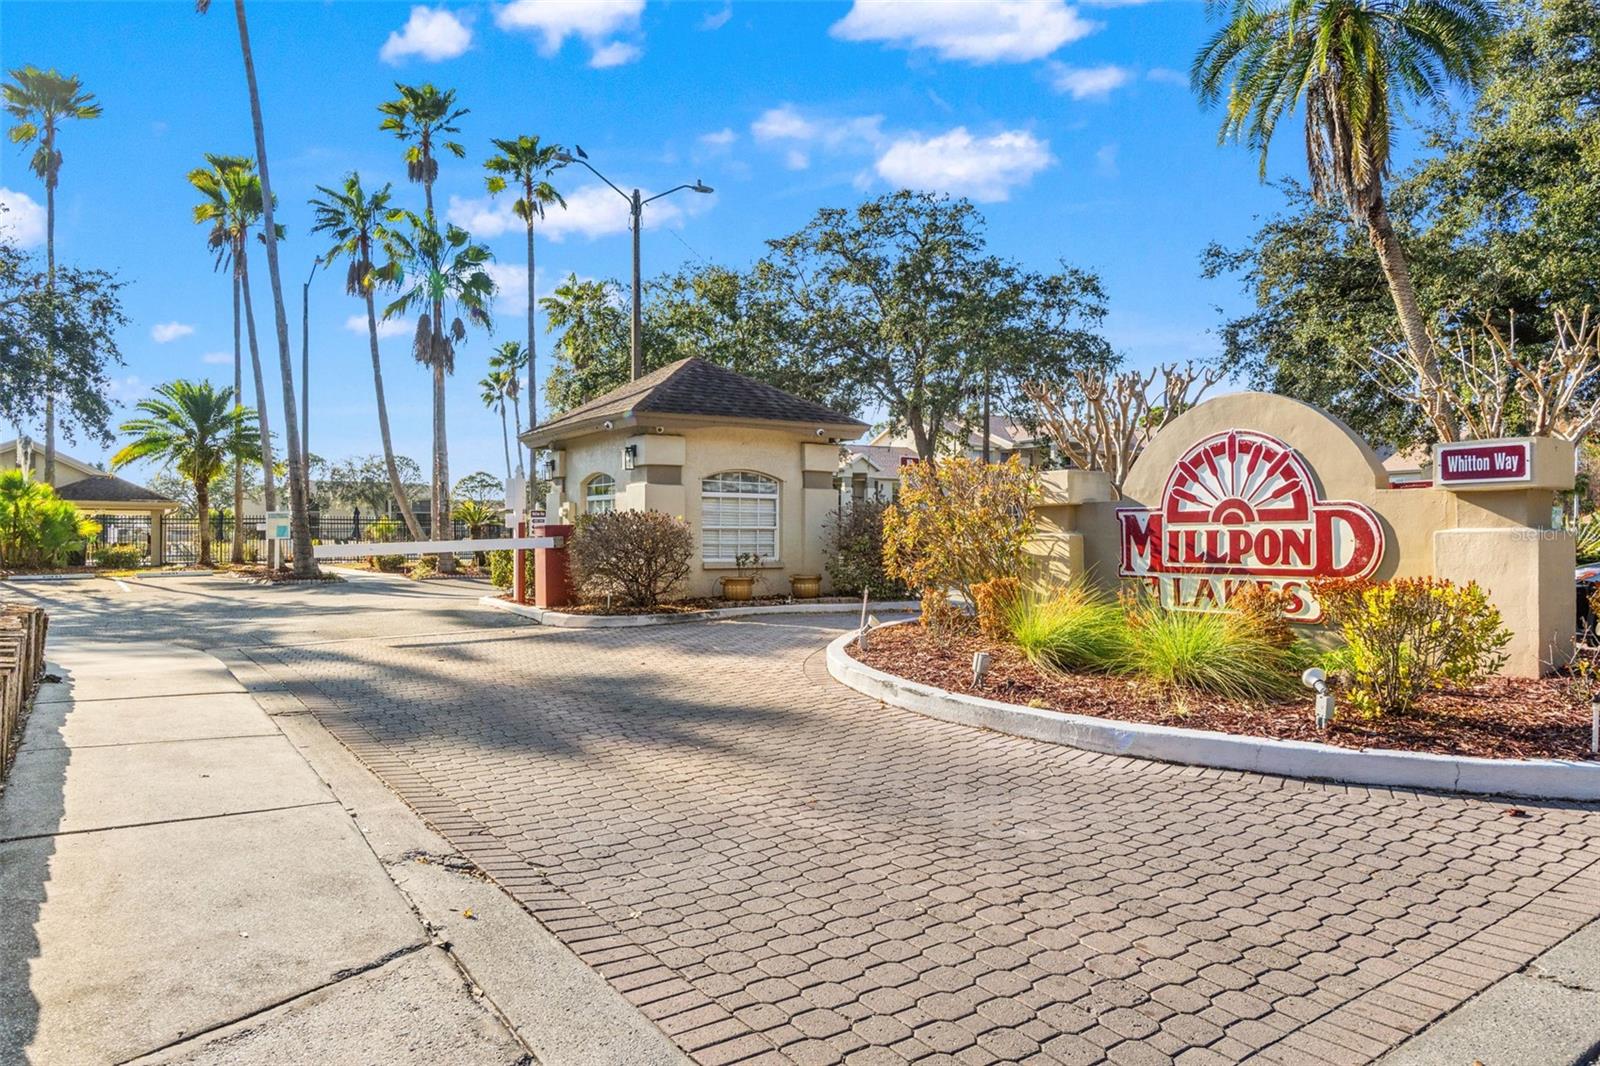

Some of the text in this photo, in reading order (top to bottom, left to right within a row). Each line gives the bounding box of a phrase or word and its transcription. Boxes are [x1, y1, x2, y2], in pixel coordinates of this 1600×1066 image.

[1447, 452, 1519, 473] Whitton Way
[1173, 577, 1303, 613] LAKS
